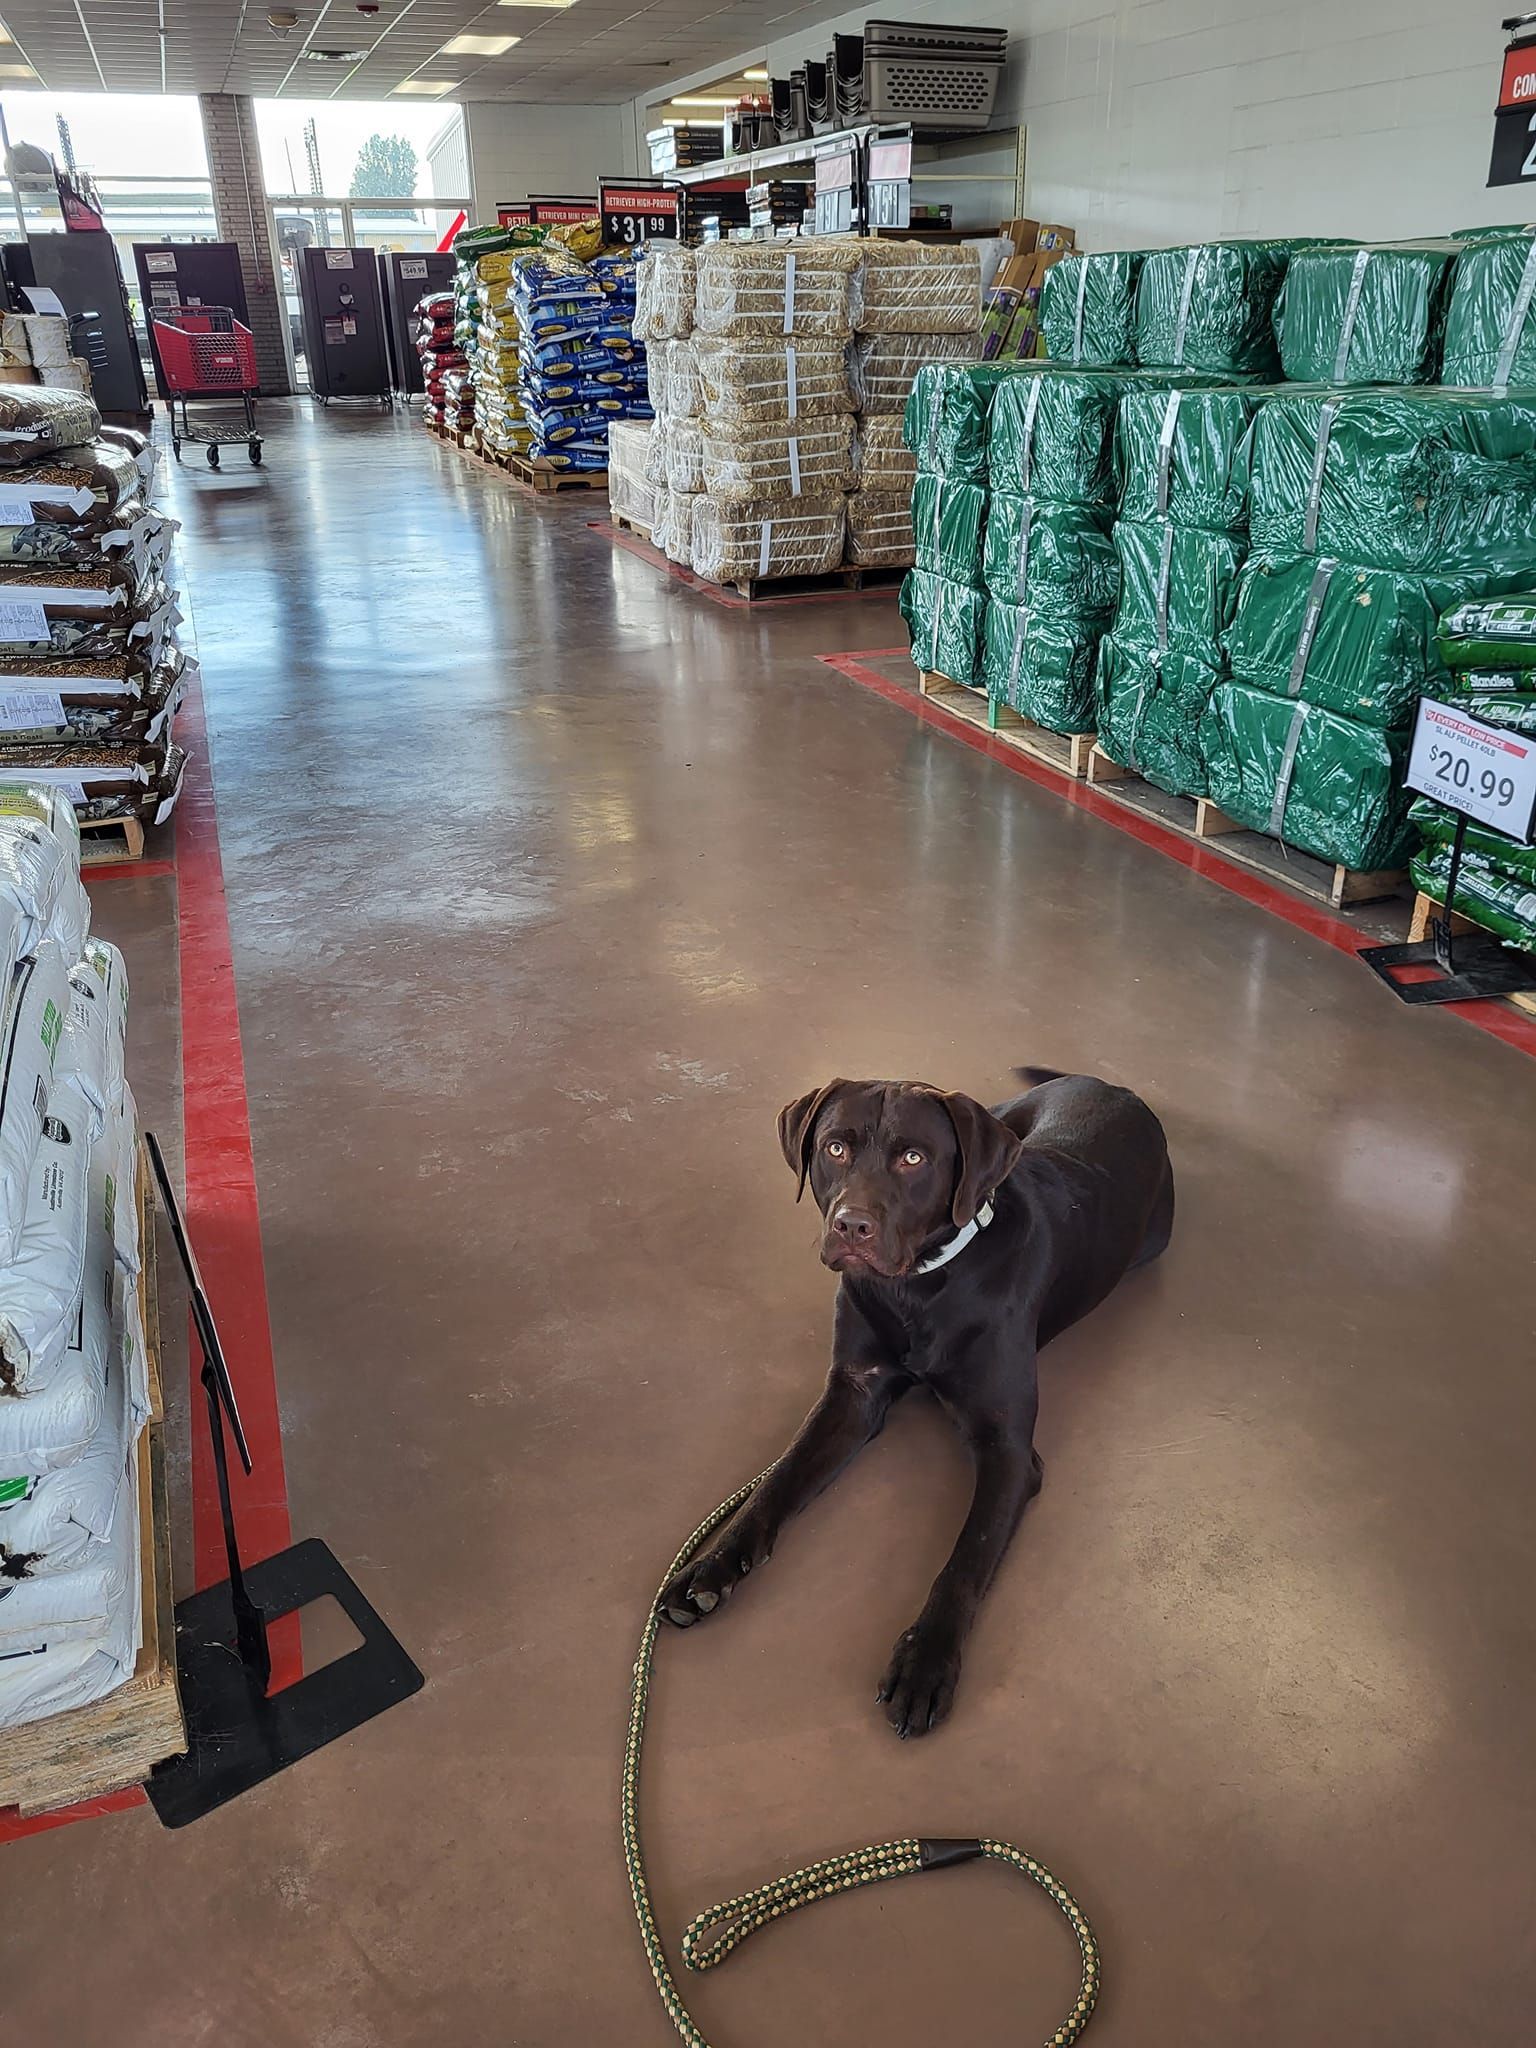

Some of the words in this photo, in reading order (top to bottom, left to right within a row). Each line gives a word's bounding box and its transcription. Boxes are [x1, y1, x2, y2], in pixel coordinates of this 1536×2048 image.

[605, 196, 635, 207] RETRIEVER
[636, 197, 676, 208] HIGH-PROTEIN
[538, 211, 567, 220] RETRIEVER
[568, 212, 580, 220] MINI
[611, 215, 619, 233] $
[623, 215, 645, 243] 31
[650, 217, 665, 232] 99
[1469, 674, 1514, 687] Standlee
[1436, 714, 1458, 729] EVERY
[1458, 722, 1472, 735] DAY
[1471, 728, 1486, 741] LOW
[1455, 733, 1478, 750] PELLET
[1429, 744, 1515, 807] $20.99
[1423, 782, 1446, 799] GREAT
[1448, 793, 1474, 812] PRICE!
